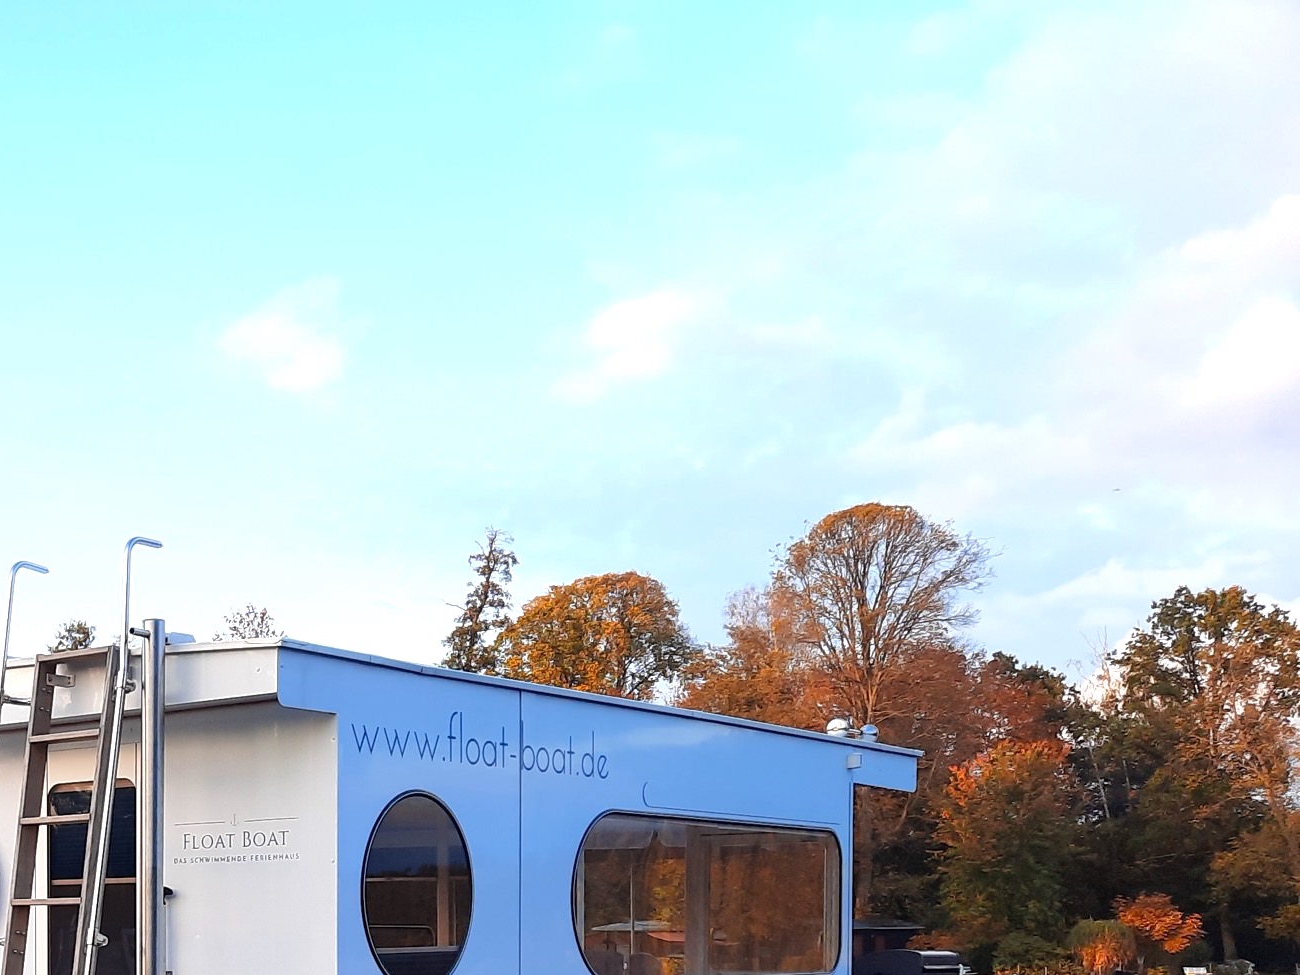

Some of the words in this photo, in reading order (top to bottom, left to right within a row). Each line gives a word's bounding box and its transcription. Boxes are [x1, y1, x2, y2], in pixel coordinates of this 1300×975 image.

[351, 711, 610, 779] www.float-boat.de
[183, 833, 236, 850] FLOAT
[242, 830, 290, 848] BOAT
[190, 855, 247, 864] SCHWIMMENDE
[250, 852, 300, 862] FERIENHAUS
